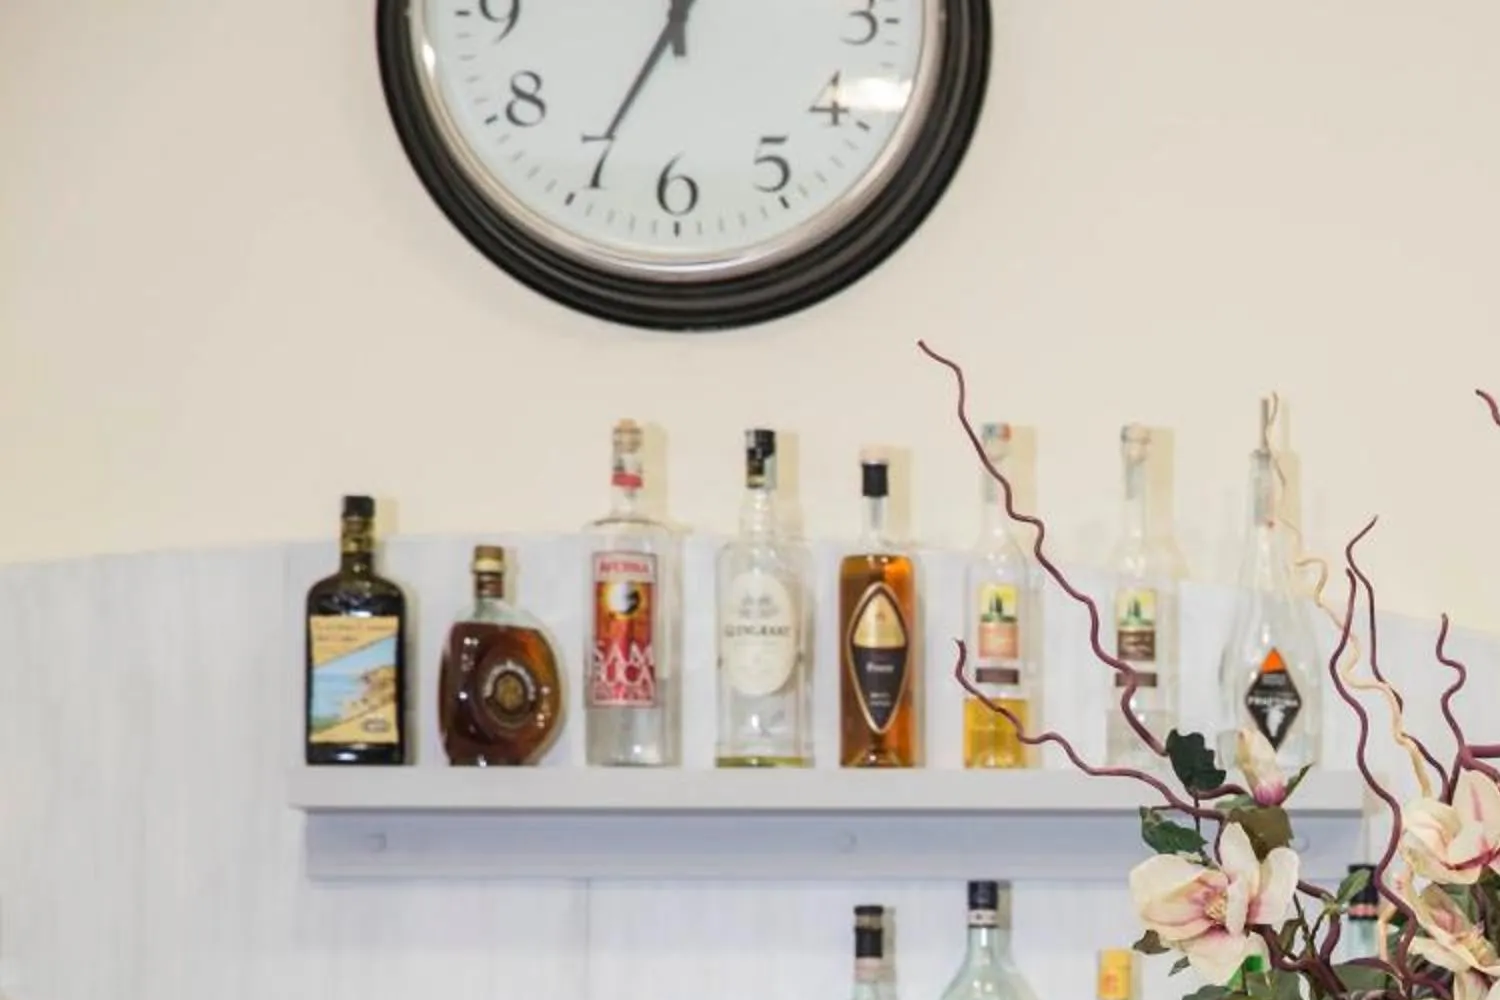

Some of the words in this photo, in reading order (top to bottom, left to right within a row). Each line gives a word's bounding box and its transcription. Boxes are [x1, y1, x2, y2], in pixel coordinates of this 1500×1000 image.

[479, 0, 520, 42] 9
[505, 70, 547, 127] 8
[808, 70, 849, 126] 4
[581, 134, 616, 189] 7
[656, 152, 700, 215] 6
[753, 135, 791, 192] 5
